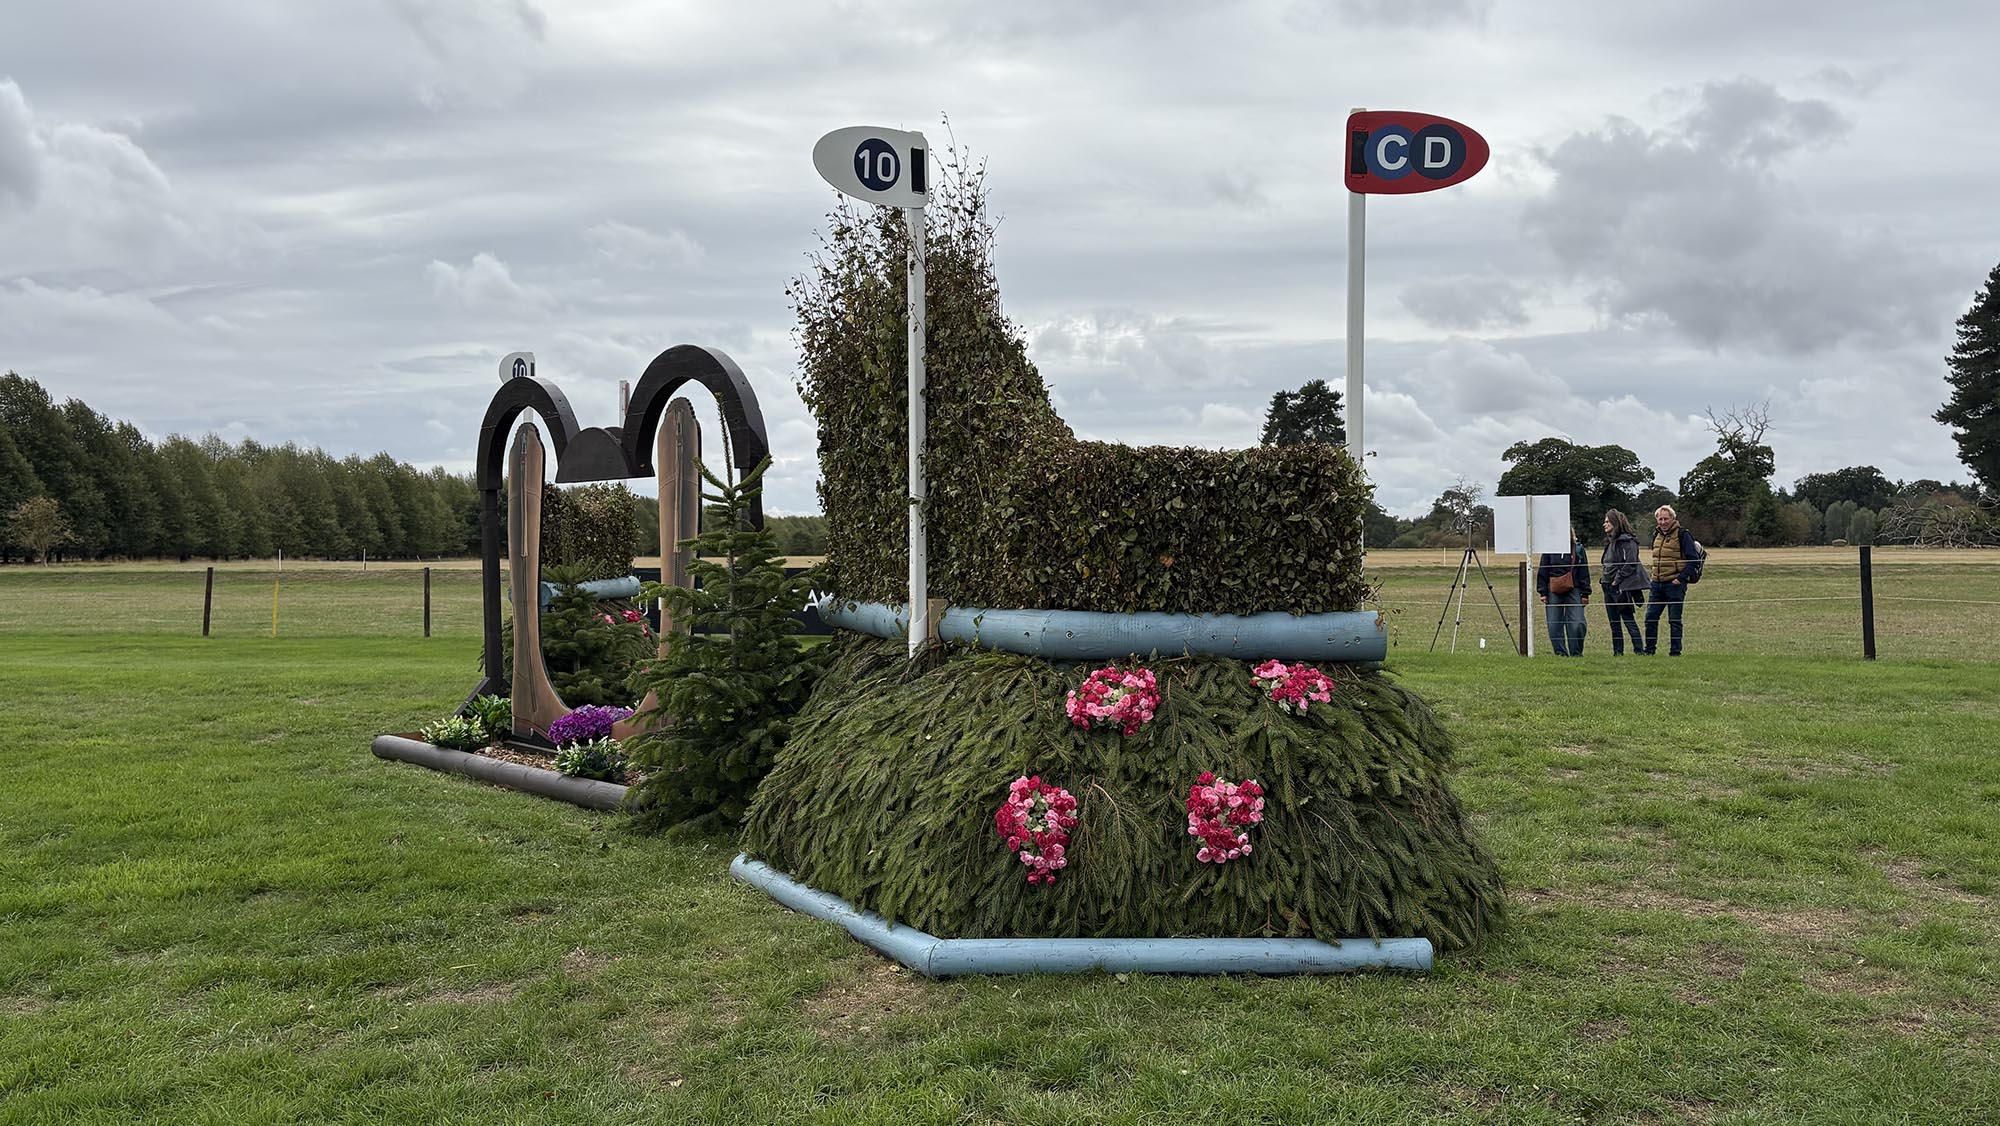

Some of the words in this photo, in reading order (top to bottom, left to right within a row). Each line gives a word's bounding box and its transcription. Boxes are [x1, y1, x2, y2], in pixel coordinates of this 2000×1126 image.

[858, 148, 896, 182] 10
[1376, 134, 1408, 171] C
[1423, 136, 1452, 168] D
